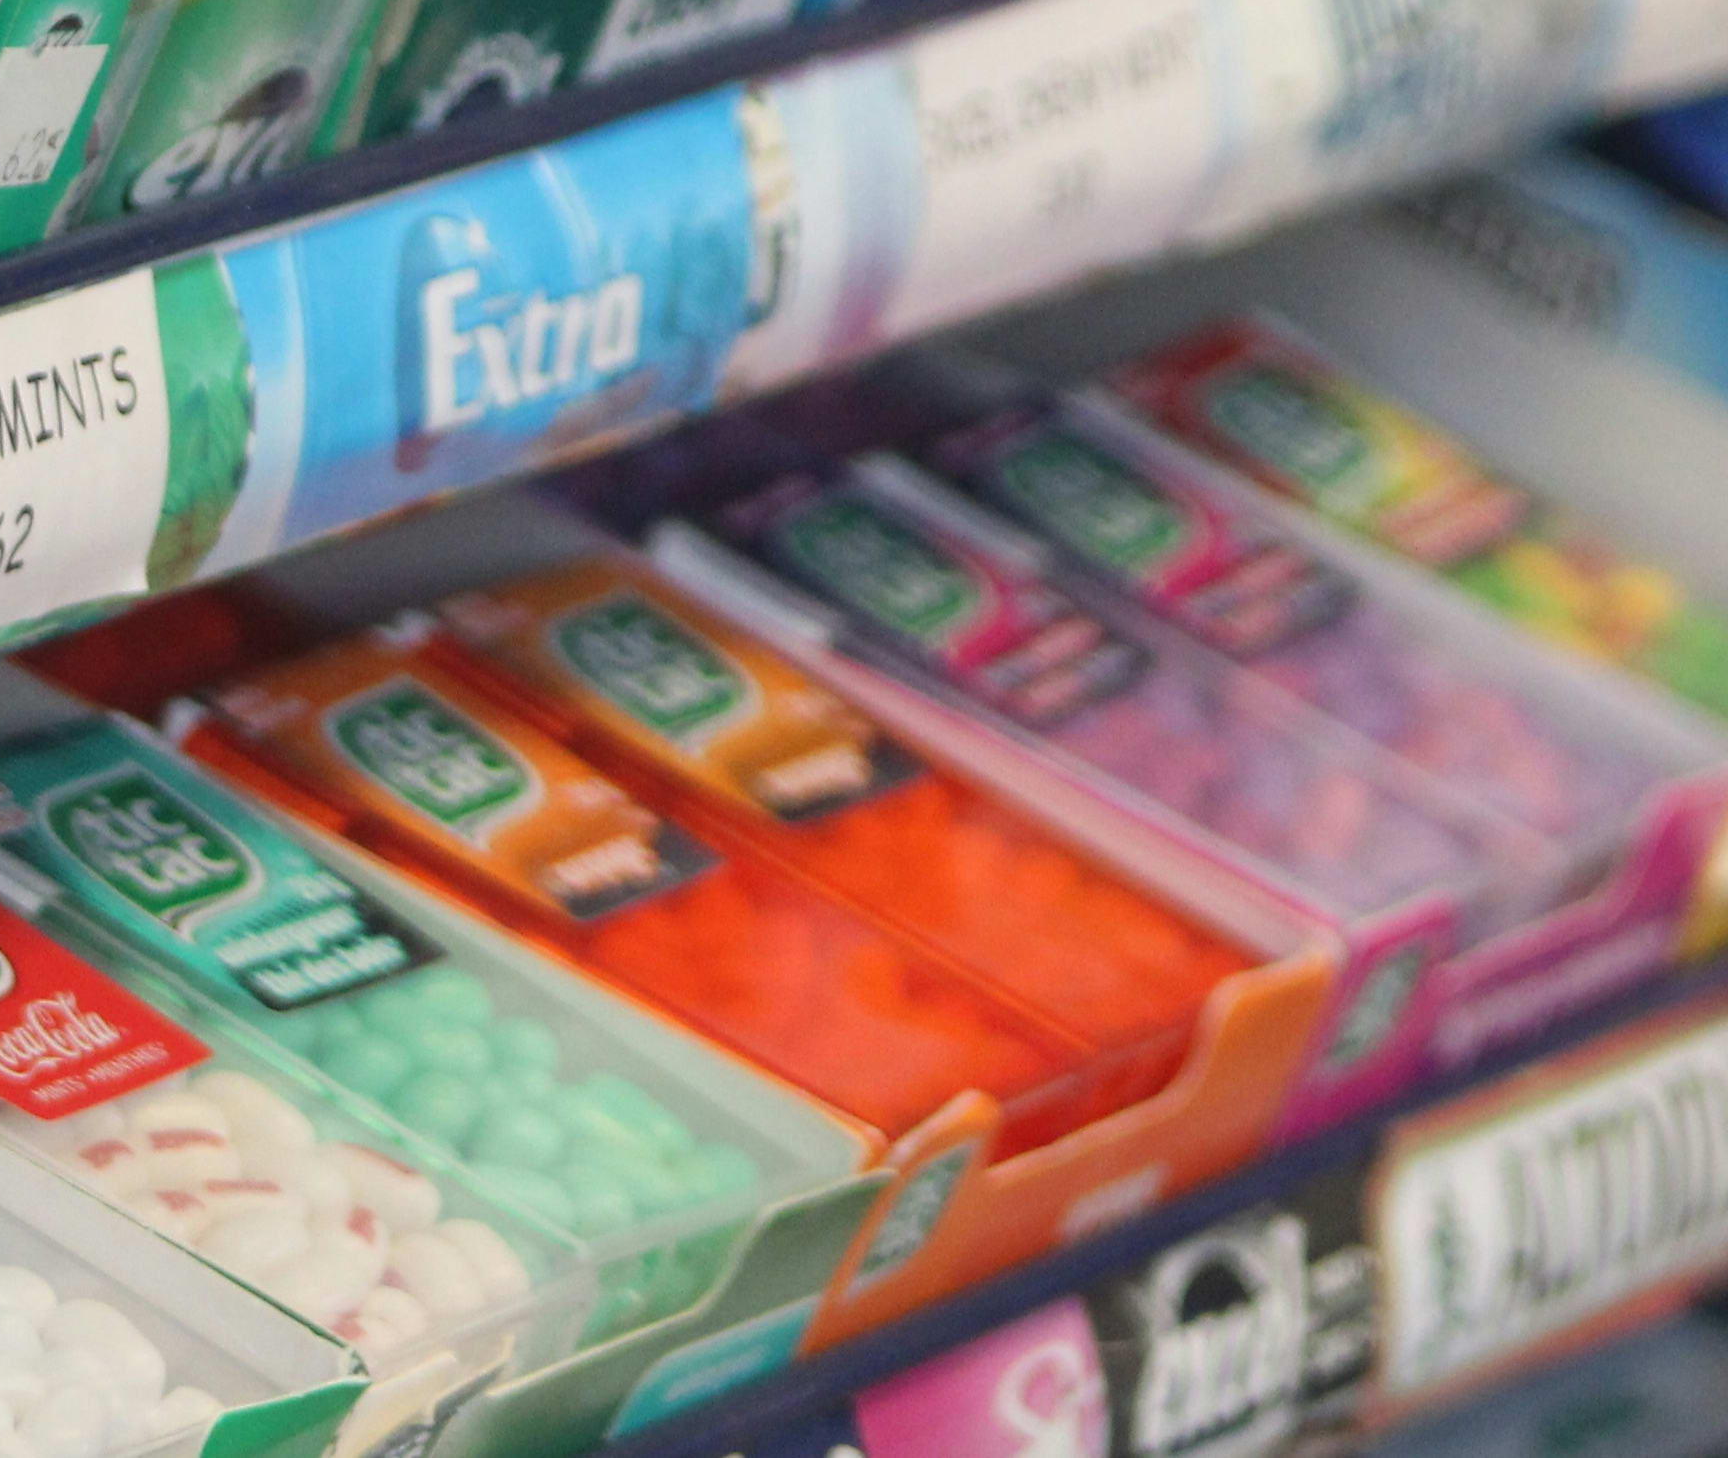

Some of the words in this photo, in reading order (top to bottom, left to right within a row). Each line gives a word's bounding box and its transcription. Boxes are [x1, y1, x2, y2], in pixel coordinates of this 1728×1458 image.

[422, 267, 646, 435] Extra
[74, 792, 178, 849] tic
[108, 828, 240, 894] tac
